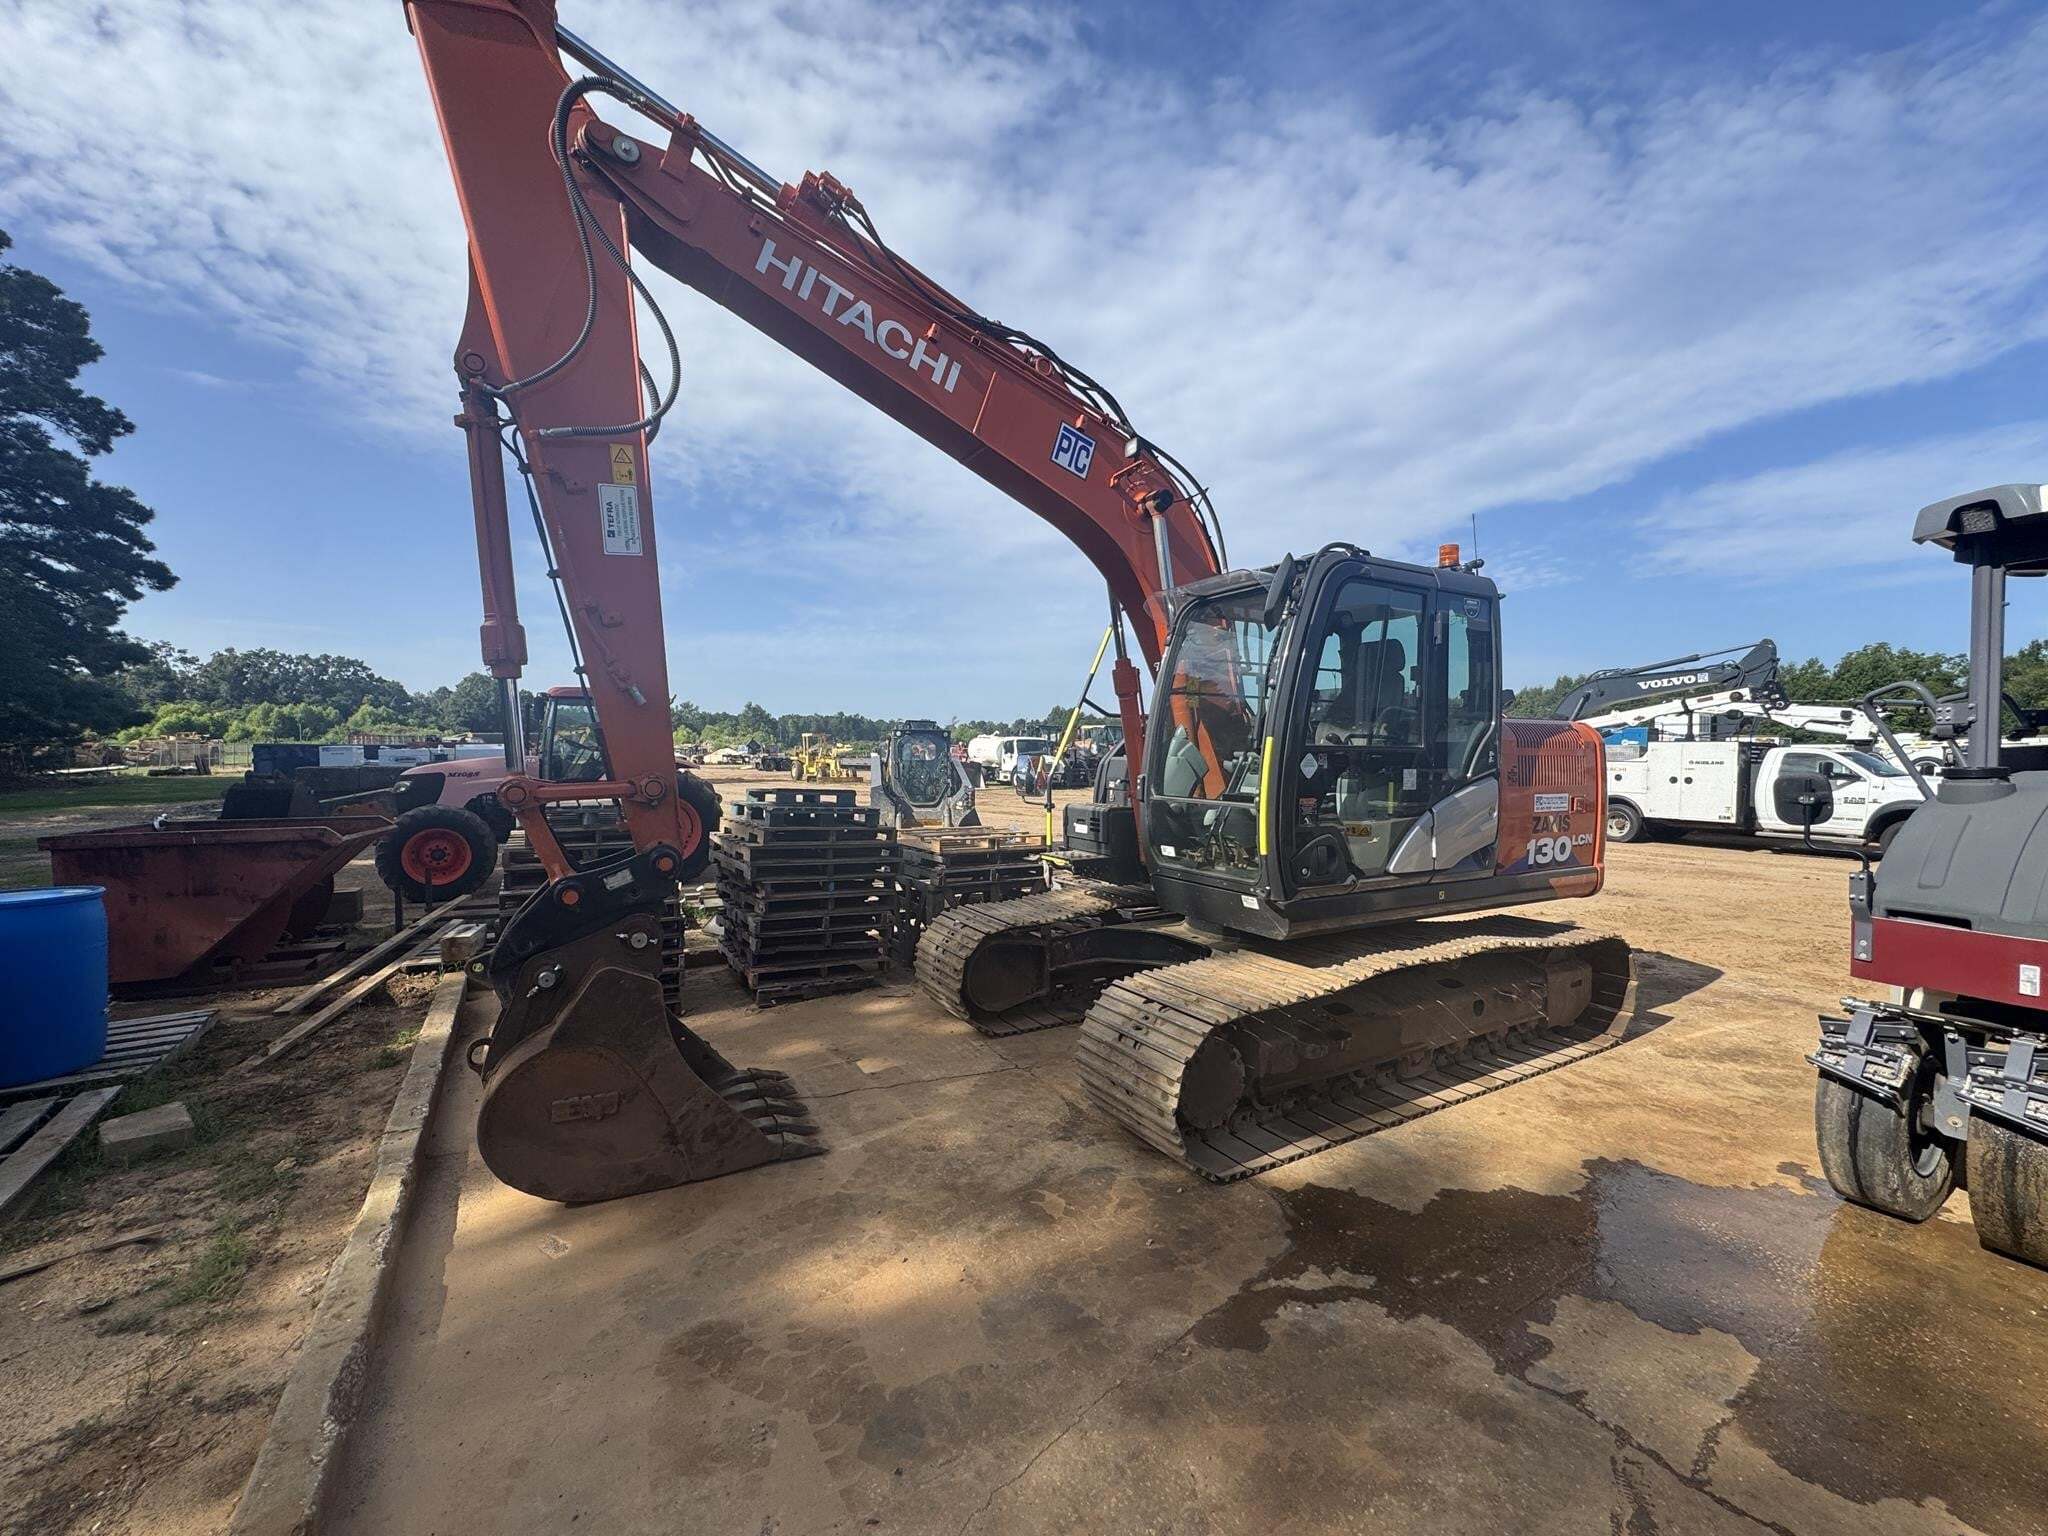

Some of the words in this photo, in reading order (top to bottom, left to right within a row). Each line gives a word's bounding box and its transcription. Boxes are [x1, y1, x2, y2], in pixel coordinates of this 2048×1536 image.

[754, 238, 963, 394] HITACHI
[1054, 425, 1094, 474] PTC
[606, 501, 616, 529] TEFRA
[1637, 675, 1697, 690] VOLVO
[1531, 815, 1571, 835] ZAXIS
[1526, 835, 1572, 866] 130
